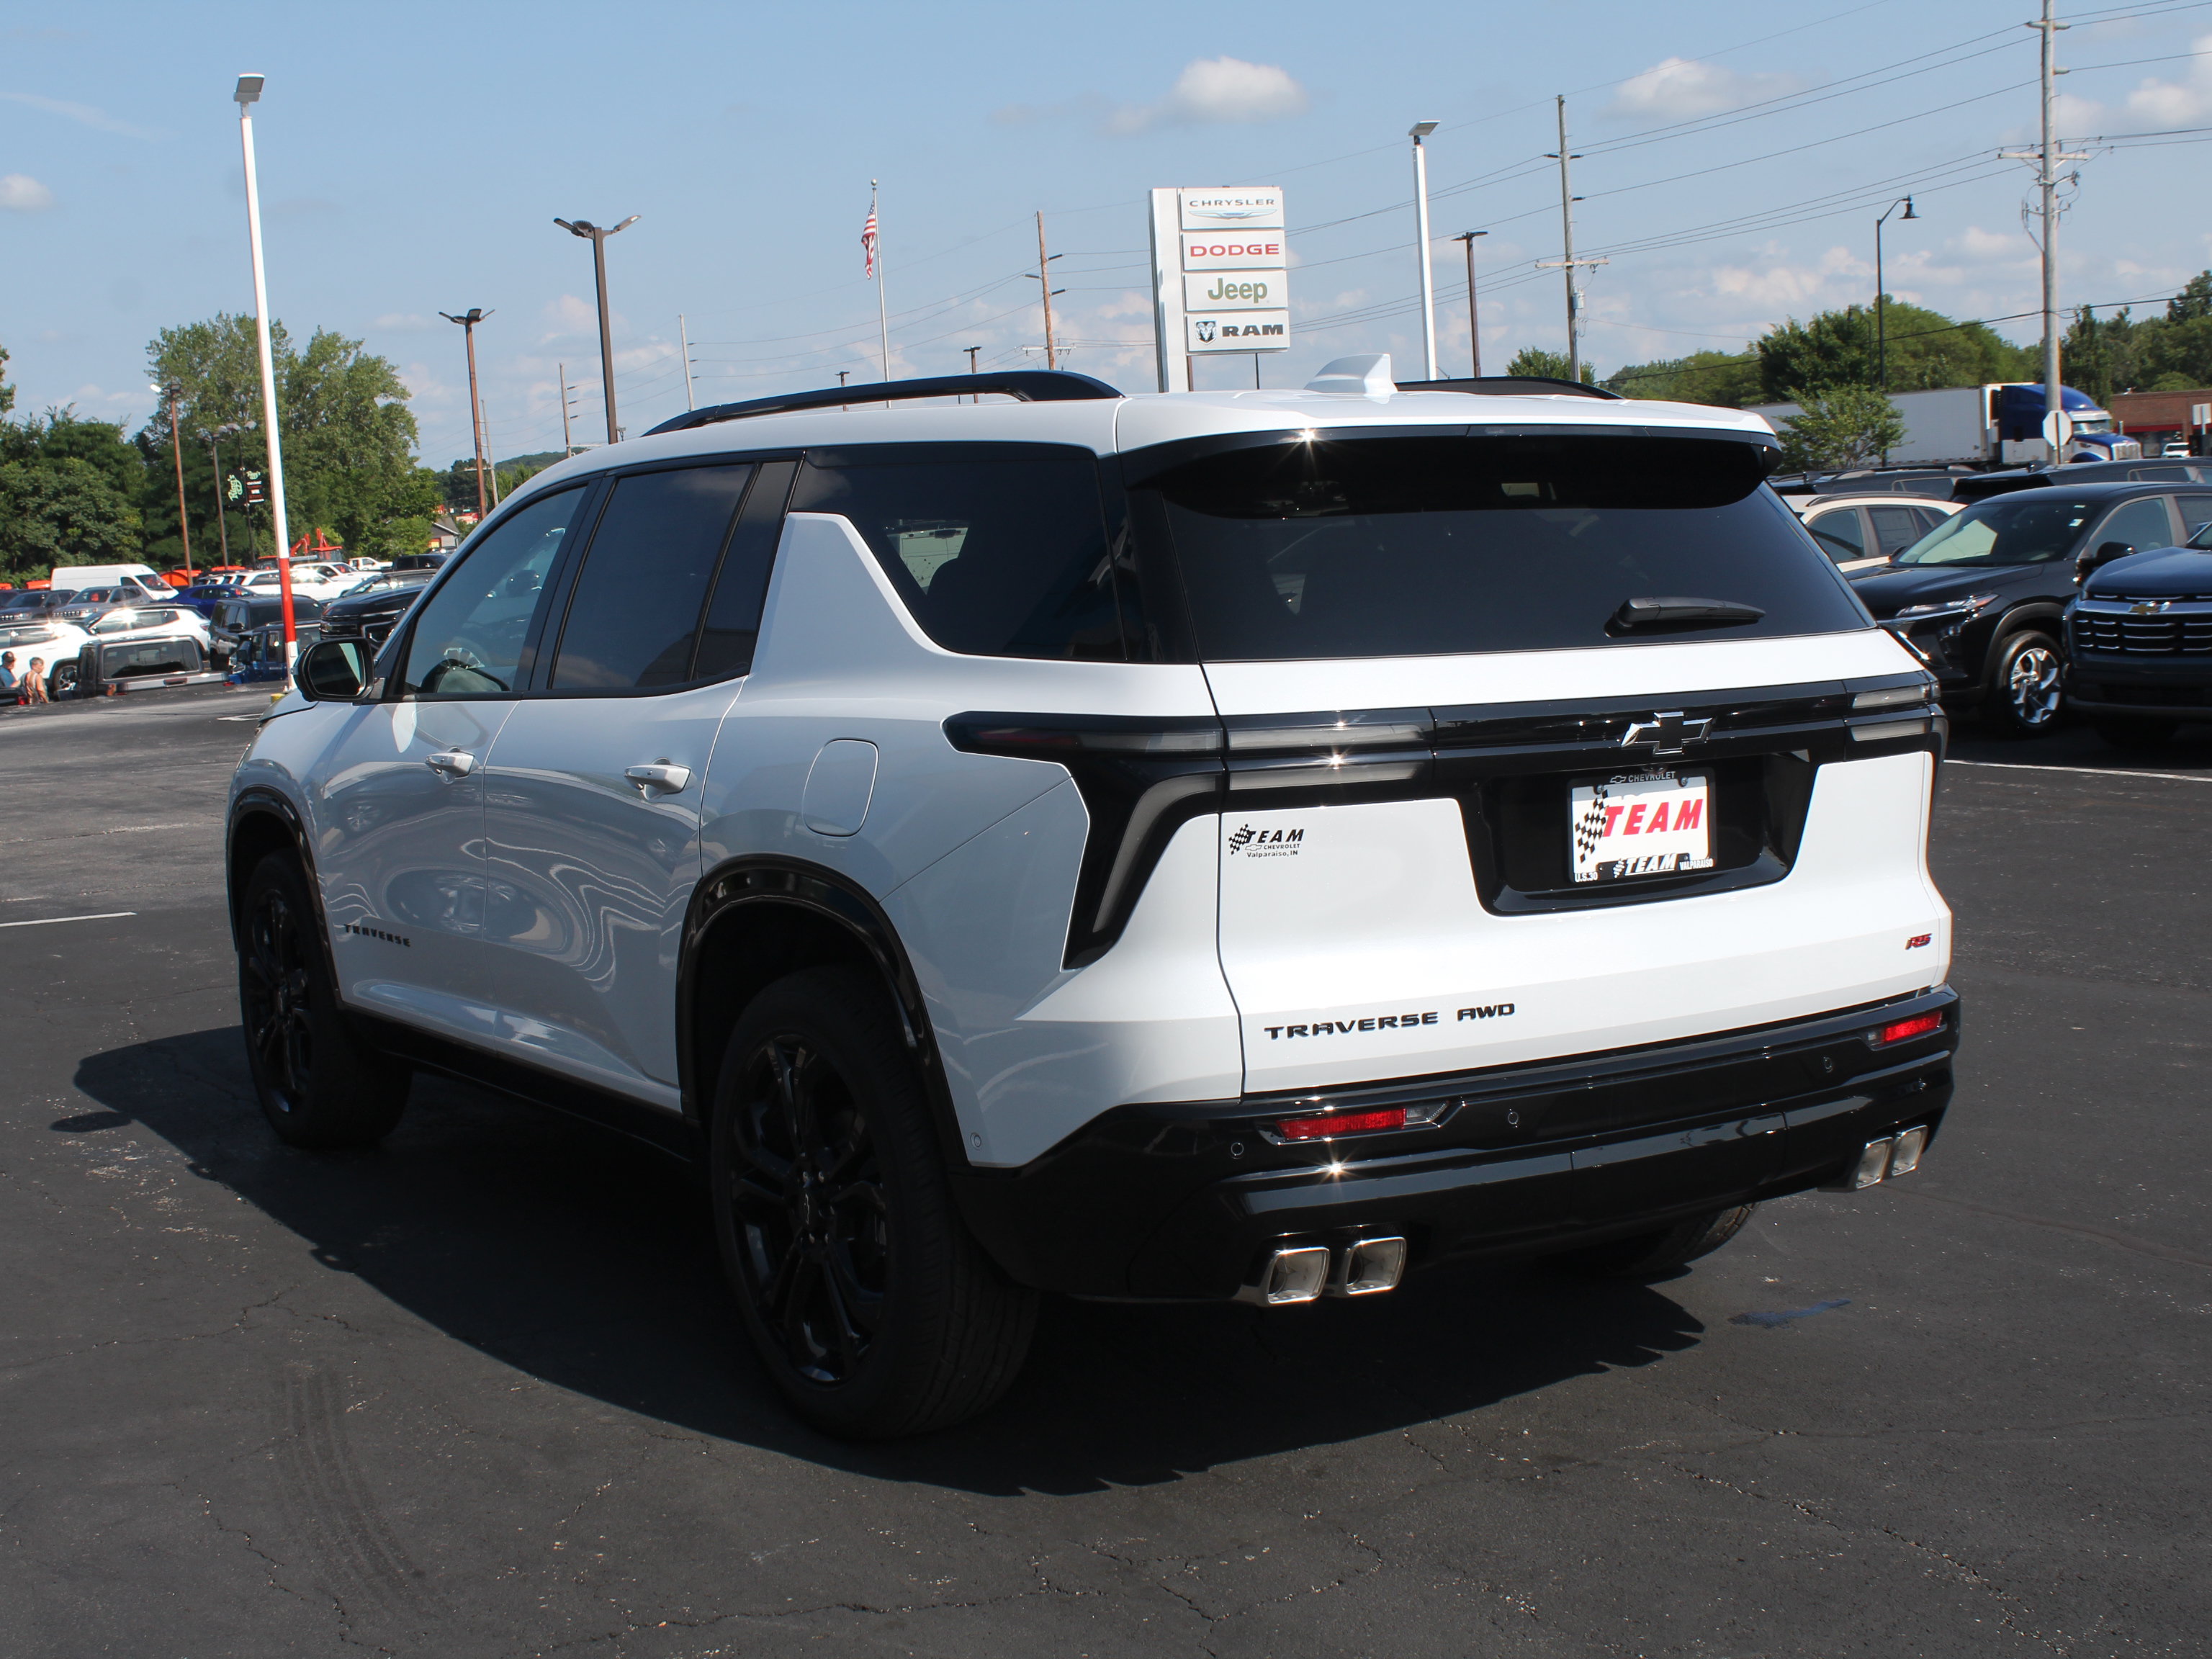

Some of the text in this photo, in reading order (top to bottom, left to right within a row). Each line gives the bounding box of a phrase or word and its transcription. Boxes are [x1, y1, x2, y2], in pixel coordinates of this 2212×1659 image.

[1190, 243, 1279, 257] DODGE
[1208, 277, 1267, 303] Jeep
[1222, 324, 1283, 337] RAM
[1628, 771, 1676, 783] CHEVROLET
[1602, 799, 1703, 837] TEAM
[1245, 829, 1304, 843] TEAM
[1625, 853, 1677, 873] TEAM
[1679, 858, 1714, 871] VALPARAISO
[343, 924, 410, 947] TRAVERSE
[1905, 933, 1932, 950] RS
[1264, 1003, 1515, 1040] TRAVERSE AWD
